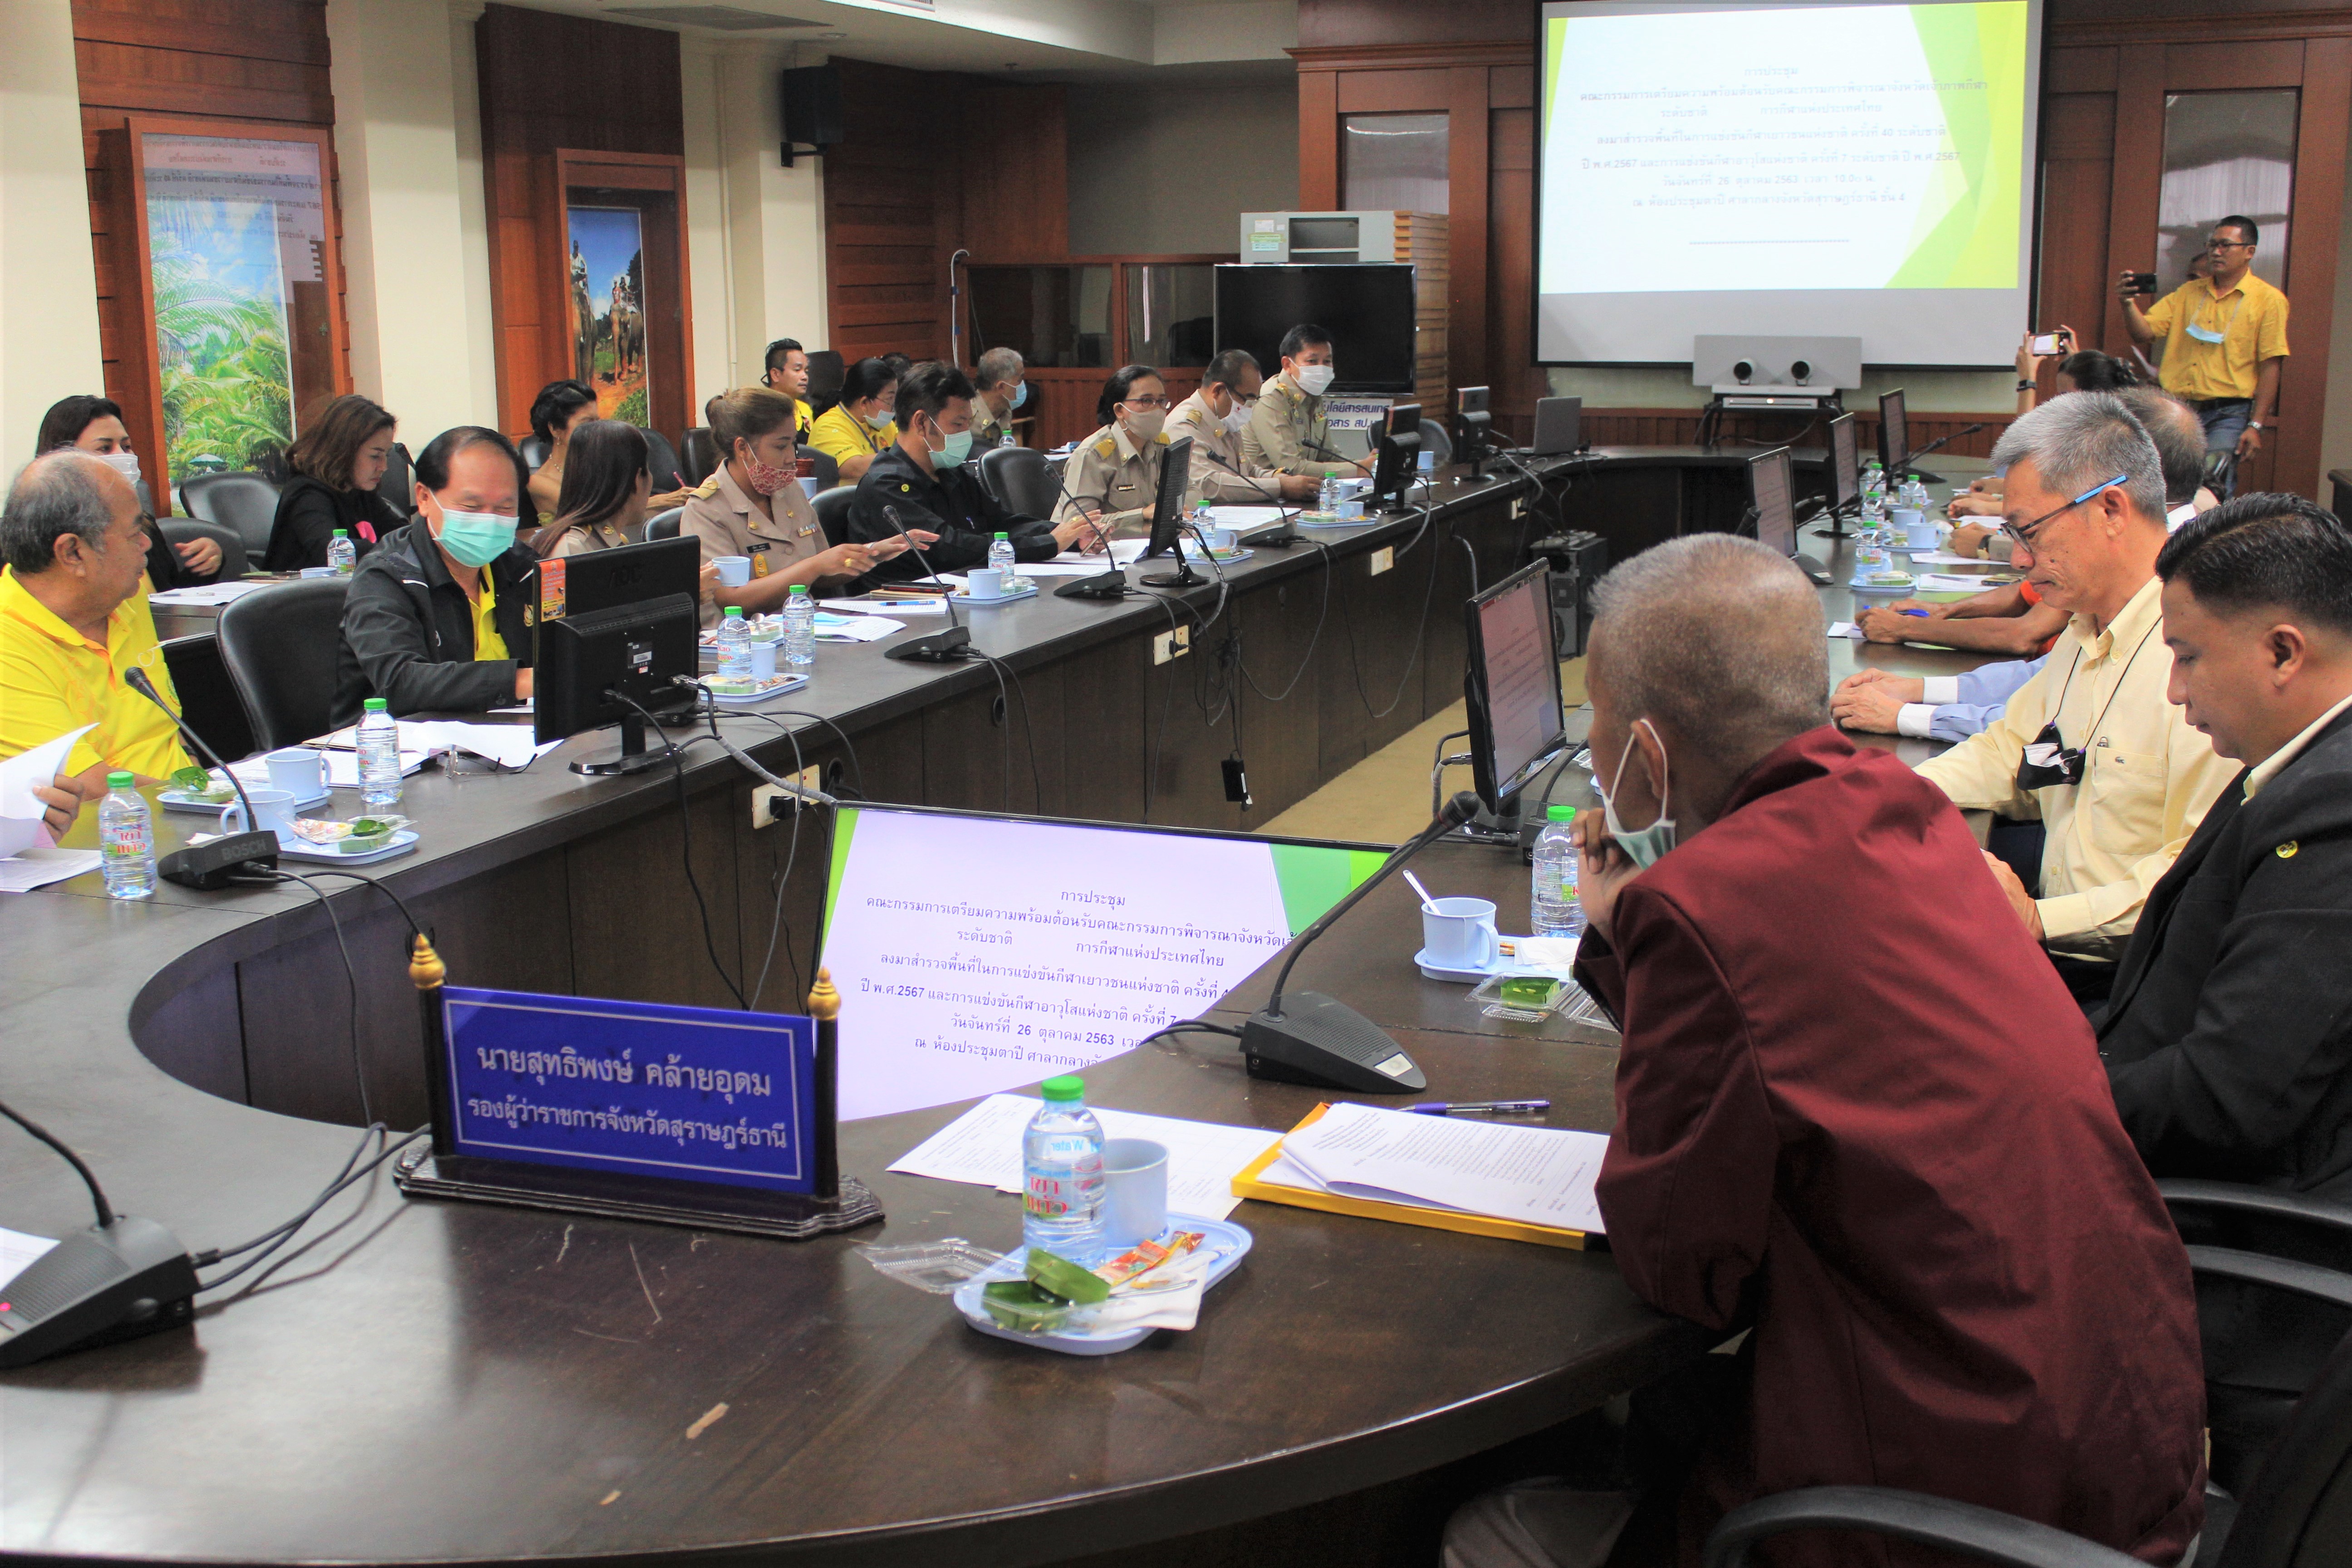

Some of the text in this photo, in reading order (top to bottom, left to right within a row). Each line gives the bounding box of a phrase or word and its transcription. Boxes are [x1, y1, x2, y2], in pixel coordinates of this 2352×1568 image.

[1881, 128, 1895, 137] 40
[1842, 153, 1847, 161] 7
[1718, 176, 1730, 185] 26
[1774, 174, 1799, 184] 2563
[1899, 191, 1906, 201] 4
[1061, 889, 1125, 910] การประชุม
[957, 926, 1225, 967] ระดับชาติ การกีฬาแห่งประเทศไทย
[881, 952, 1218, 998] ลงมาสำรวจพื้นที่ในการแข่งขันกีฬาเยาวชนแห่งชาติ ครั้งที่
[860, 977, 1177, 1026] ปี พ.ศ.2567 และการแข่งขันกีฬาอาวุโสแห่งชาติ ครั้งที่ 7
[951, 1012, 1011, 1034] วันจันทร์ที่
[1017, 1024, 1032, 1036] 26
[1039, 1026, 1082, 1043] ตุลาคม
[1085, 1032, 1115, 1045] 2563
[915, 1037, 926, 1048] ณ
[933, 1034, 1024, 1061] ห้องประชุมตาปี
[476, 1046, 771, 1103] นายสุทธิพงษ์ คล้ายอุดม
[467, 1094, 787, 1150] รองผู้ว่าราชการจังหวัดสุราษฎร์ธานี
